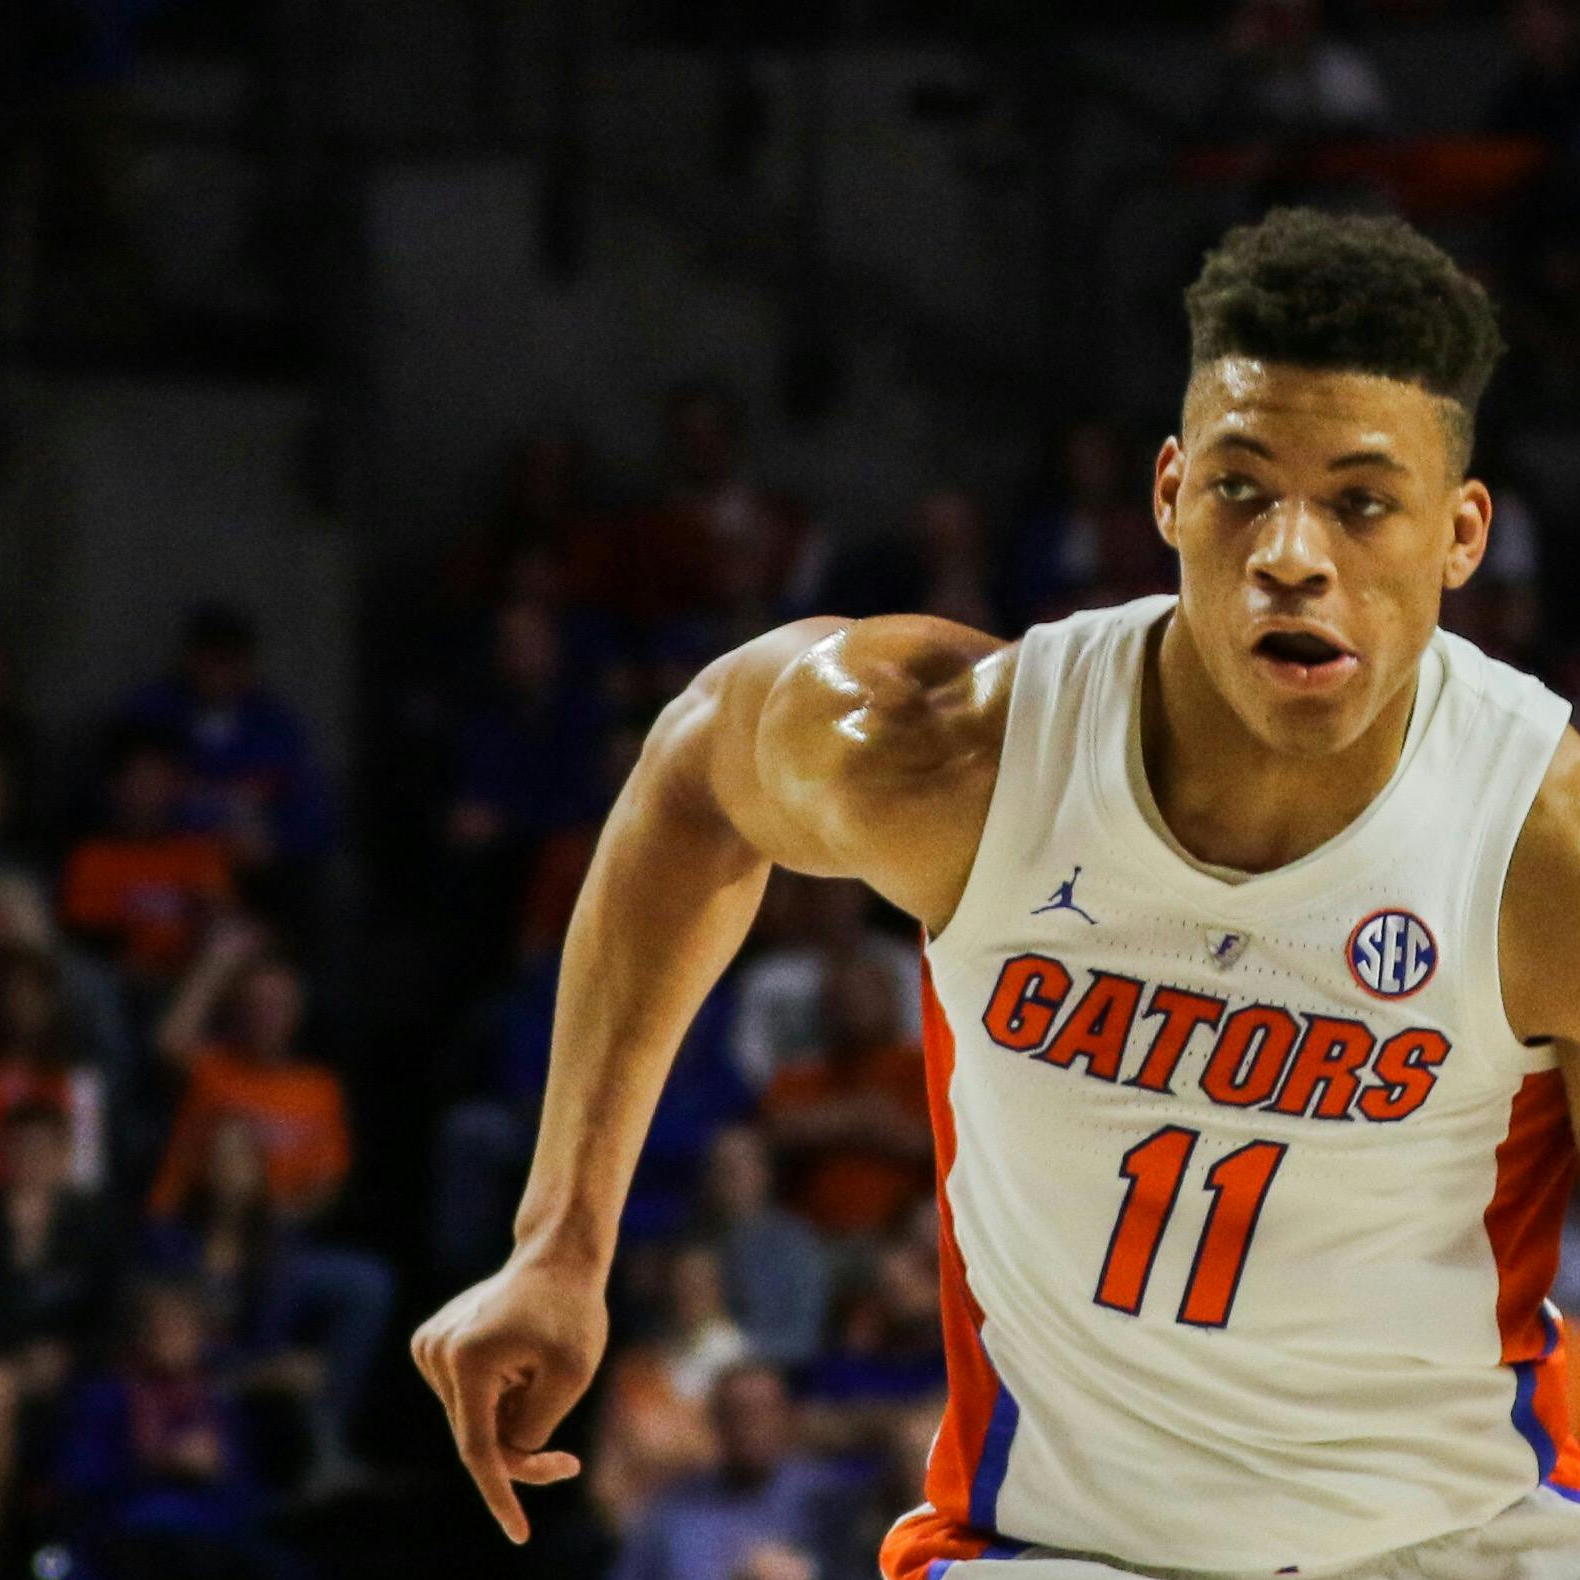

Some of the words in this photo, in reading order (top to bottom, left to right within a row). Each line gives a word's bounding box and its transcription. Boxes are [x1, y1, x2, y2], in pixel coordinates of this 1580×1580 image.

[982, 952, 1452, 1122] GATORS
[1353, 914, 1431, 993] SEC
[1093, 1123, 1289, 1329] 11
